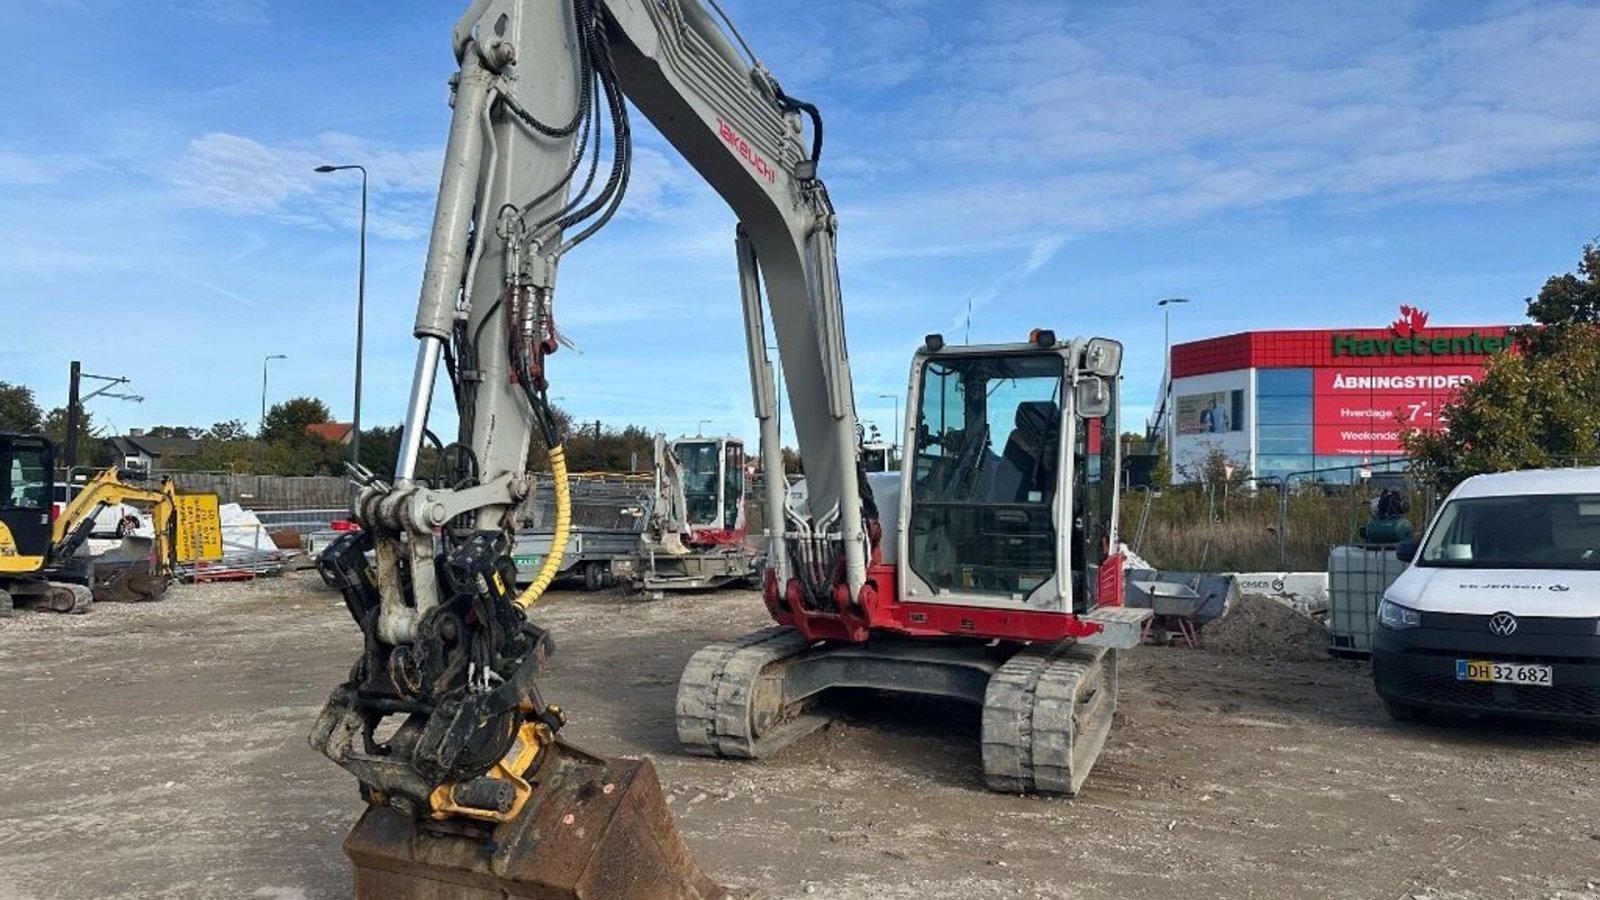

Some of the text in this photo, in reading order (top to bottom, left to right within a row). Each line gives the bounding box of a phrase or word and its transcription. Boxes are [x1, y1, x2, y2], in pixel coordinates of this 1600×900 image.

[1334, 333, 1514, 356] Havecenter
[1340, 408, 1393, 418] Hverdage
[1468, 664, 1549, 683] DH 32 682
